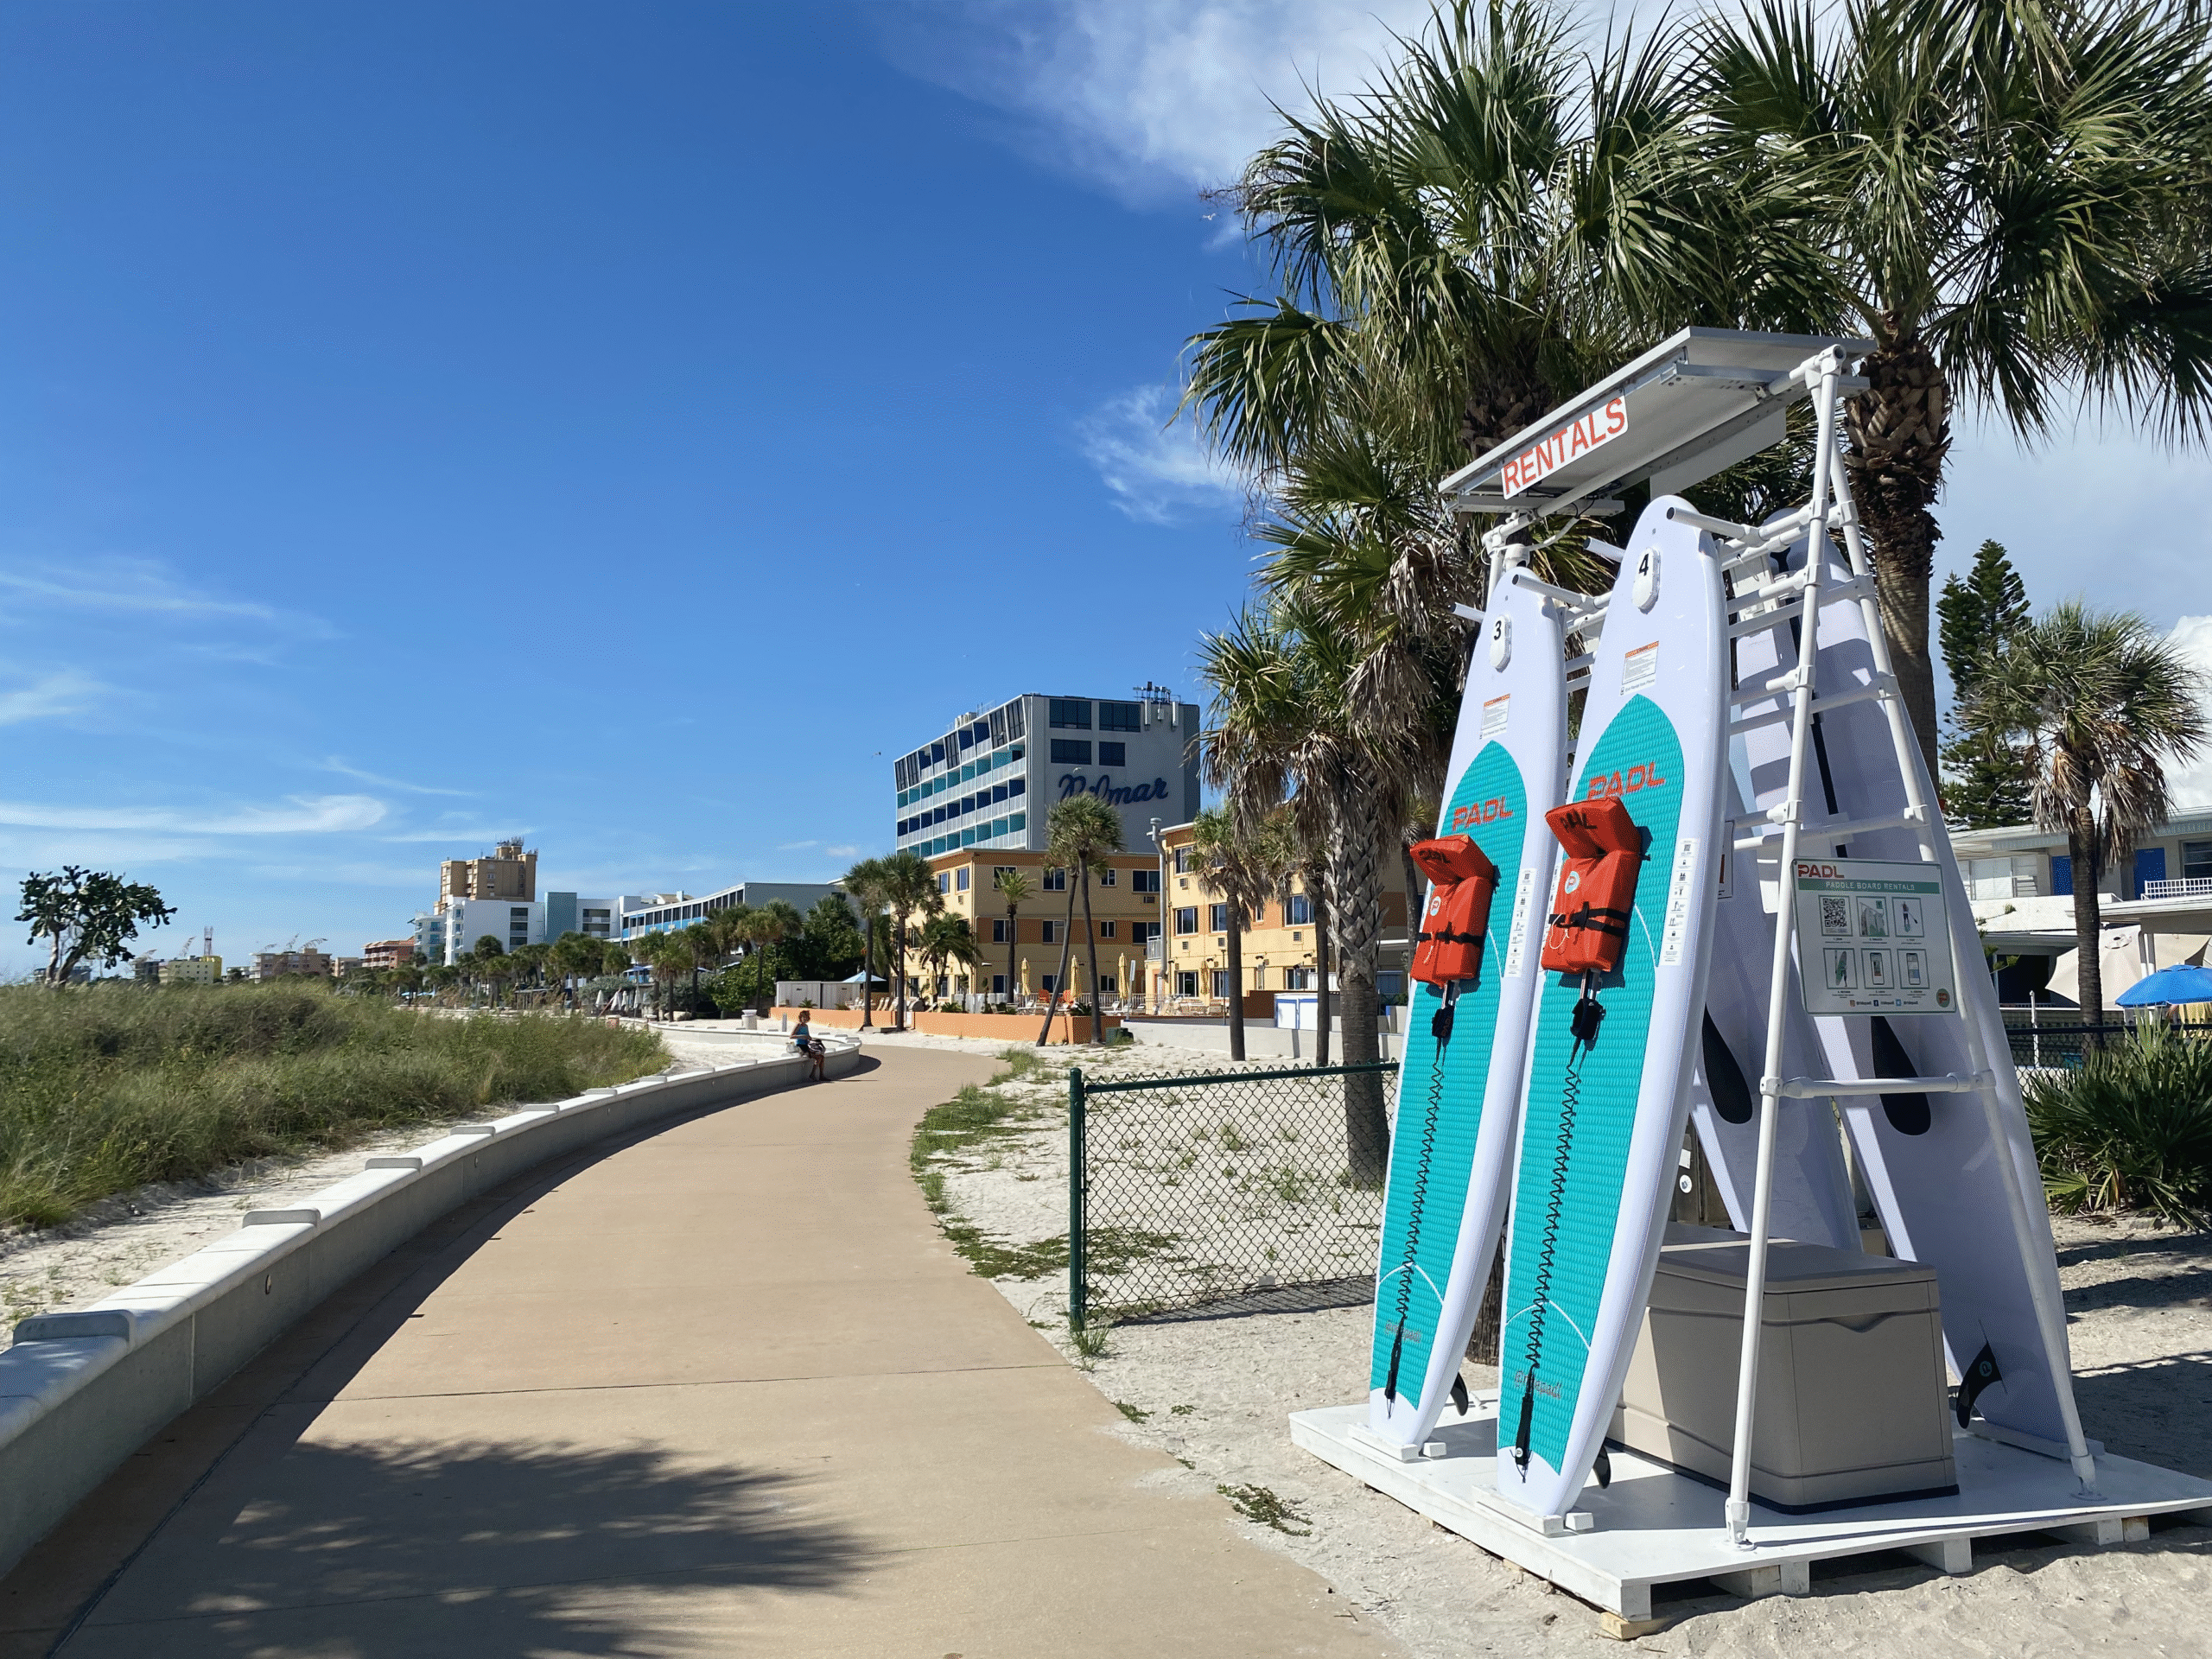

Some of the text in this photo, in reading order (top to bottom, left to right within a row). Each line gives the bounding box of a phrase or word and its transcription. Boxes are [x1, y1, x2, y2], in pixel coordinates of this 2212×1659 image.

[1503, 397, 1625, 494] RENTALS
[1638, 553, 1649, 576] 4
[1494, 620, 1502, 639] 3
[1058, 773, 1168, 806] Blmar
[1586, 761, 1666, 800] PADL
[1452, 796, 1514, 832] PADL
[1797, 864, 1845, 879] PADL
[1825, 880, 1855, 889] PADDLE
